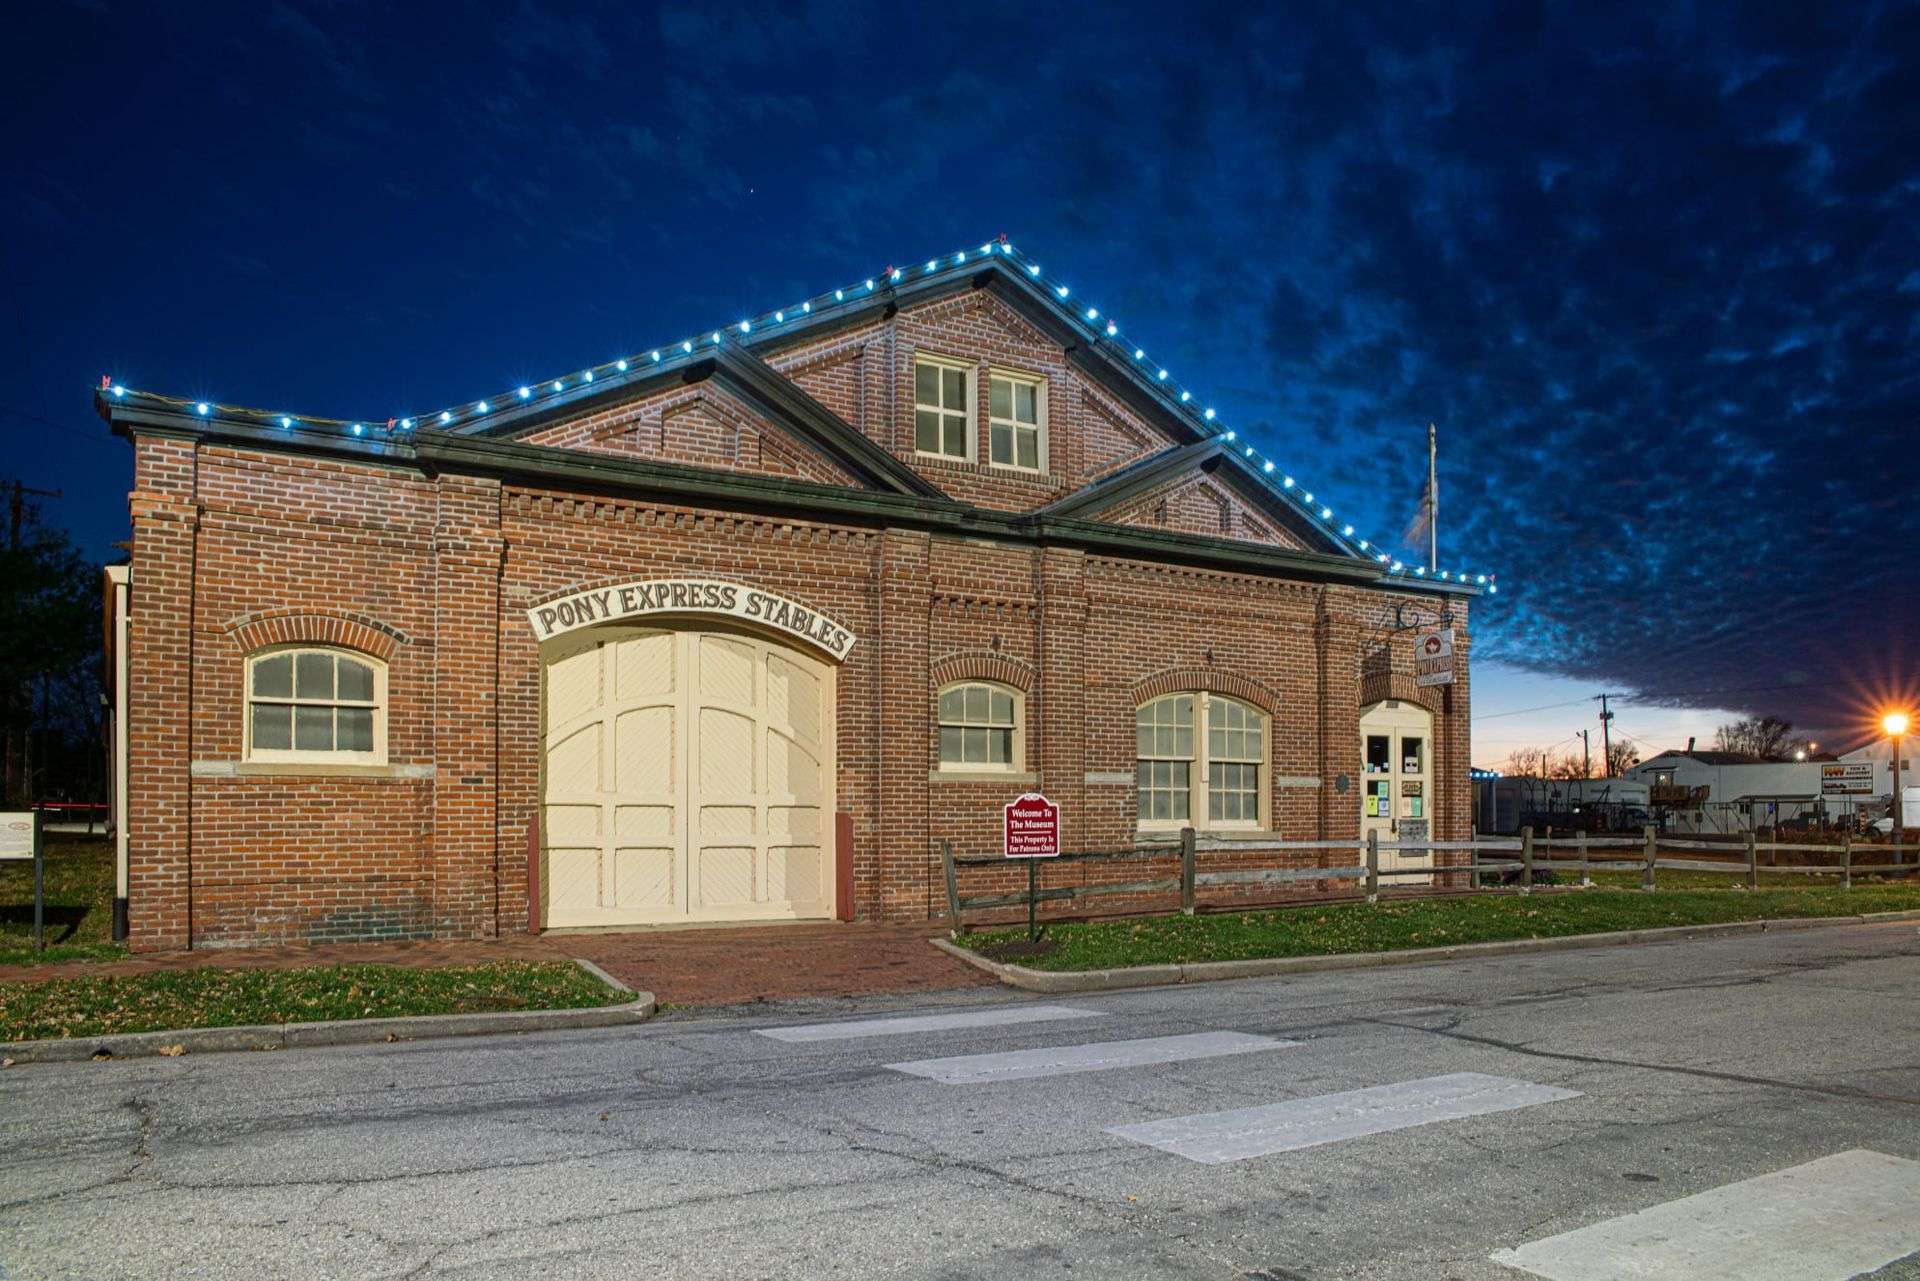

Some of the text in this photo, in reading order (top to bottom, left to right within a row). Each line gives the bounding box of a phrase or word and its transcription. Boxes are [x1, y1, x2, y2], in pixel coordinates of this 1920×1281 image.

[537, 584, 849, 653] PONY EXPRESS STABLES
[1012, 809, 1052, 817] Welcome To
[1010, 820, 1054, 829] The Museum
[1011, 836, 1023, 844] This
[1024, 836, 1047, 845] Property
[1041, 844, 1055, 854] Only
